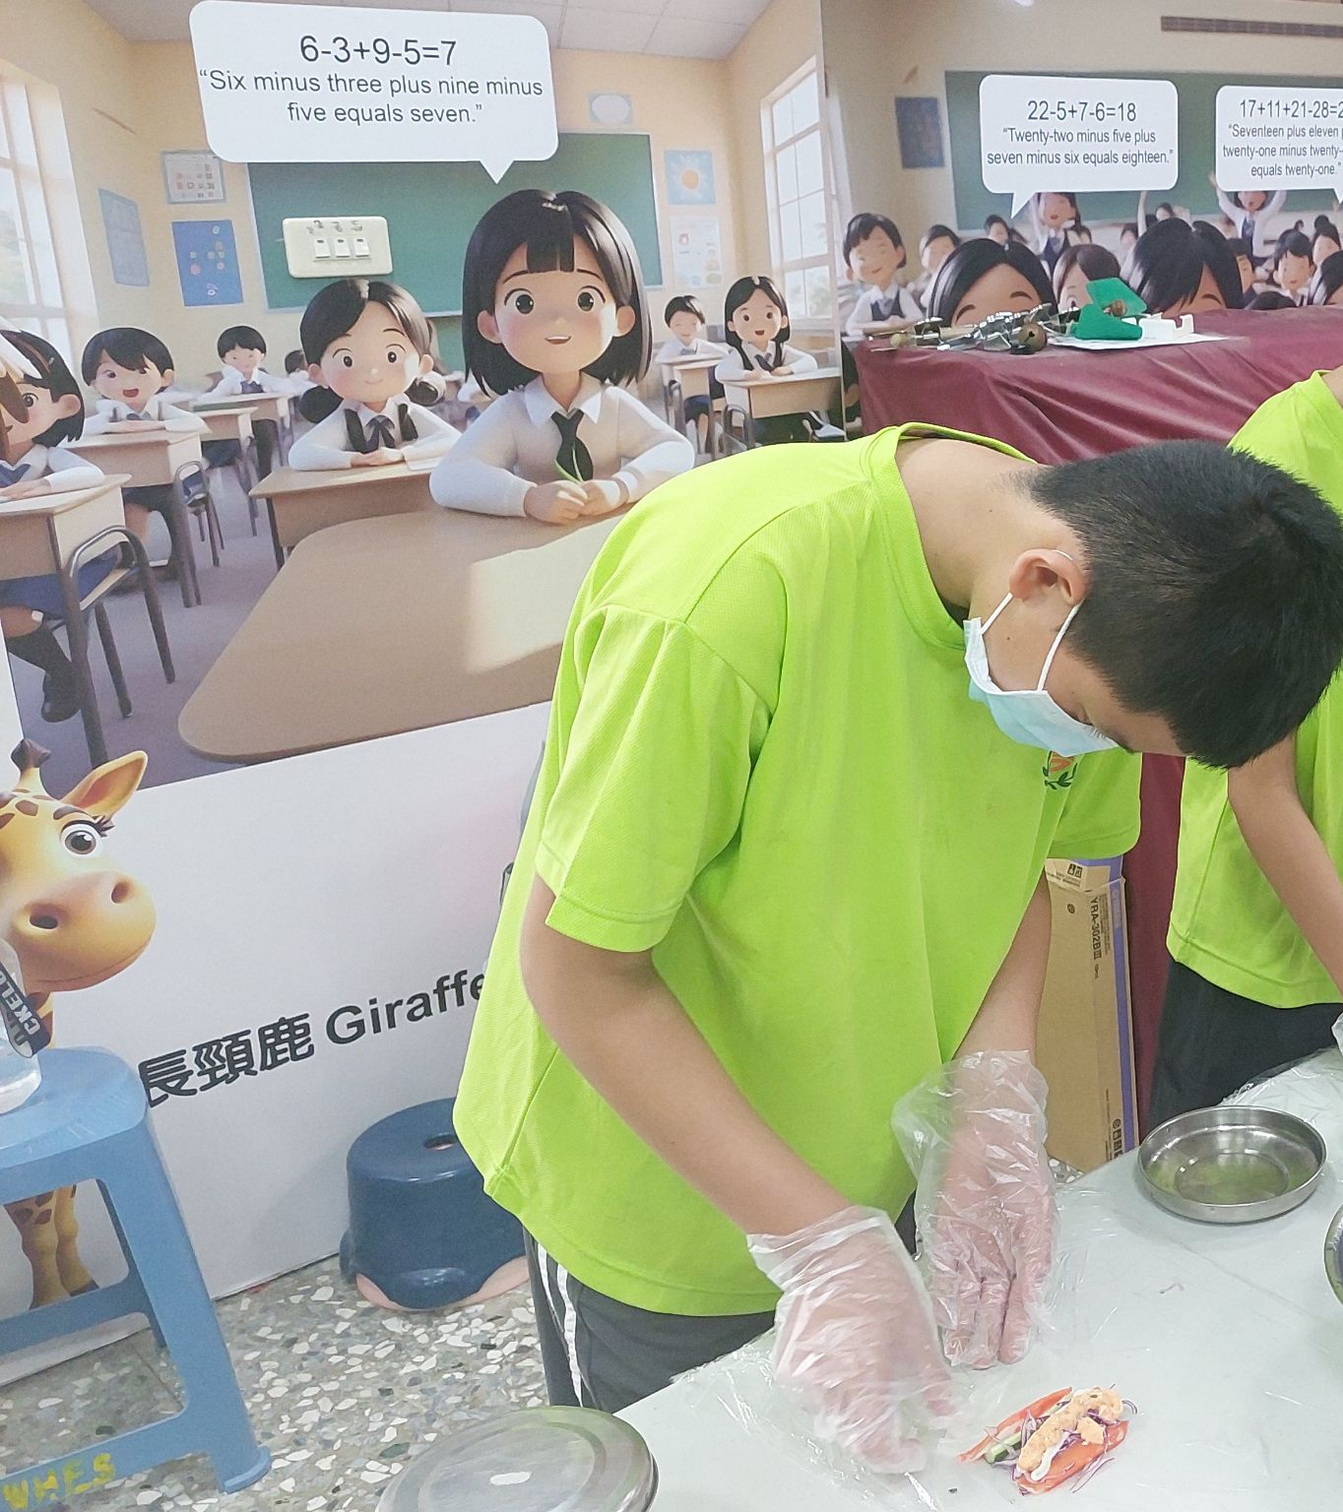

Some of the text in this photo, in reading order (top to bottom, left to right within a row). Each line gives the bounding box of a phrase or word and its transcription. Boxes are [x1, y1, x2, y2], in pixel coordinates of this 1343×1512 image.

[300, 34, 457, 66] 6-3+9-5=7
[253, 71, 321, 92] minus
[327, 73, 382, 93] three
[389, 75, 432, 97] plus
[438, 76, 480, 95] nine
[486, 78, 544, 96] minus
[287, 101, 327, 122] five
[333, 104, 404, 127] equals
[1027, 100, 1137, 122] 22-5+7-6=18
[1076, 129, 1110, 143] minus
[1113, 129, 1132, 143] five
[1134, 130, 1156, 146] plus
[1287, 125, 1307, 140] plus
[1309, 125, 1340, 138] eleven
[987, 153, 1024, 165] seven
[1026, 150, 1062, 165] minus
[1064, 150, 1080, 165] six
[1082, 150, 1120, 167] equals
[1223, 144, 1277, 160] twenty-one
[1279, 144, 1308, 157] minus
[1251, 162, 1283, 178] equals
[138, 1012, 315, 1109] 長頸鹿
